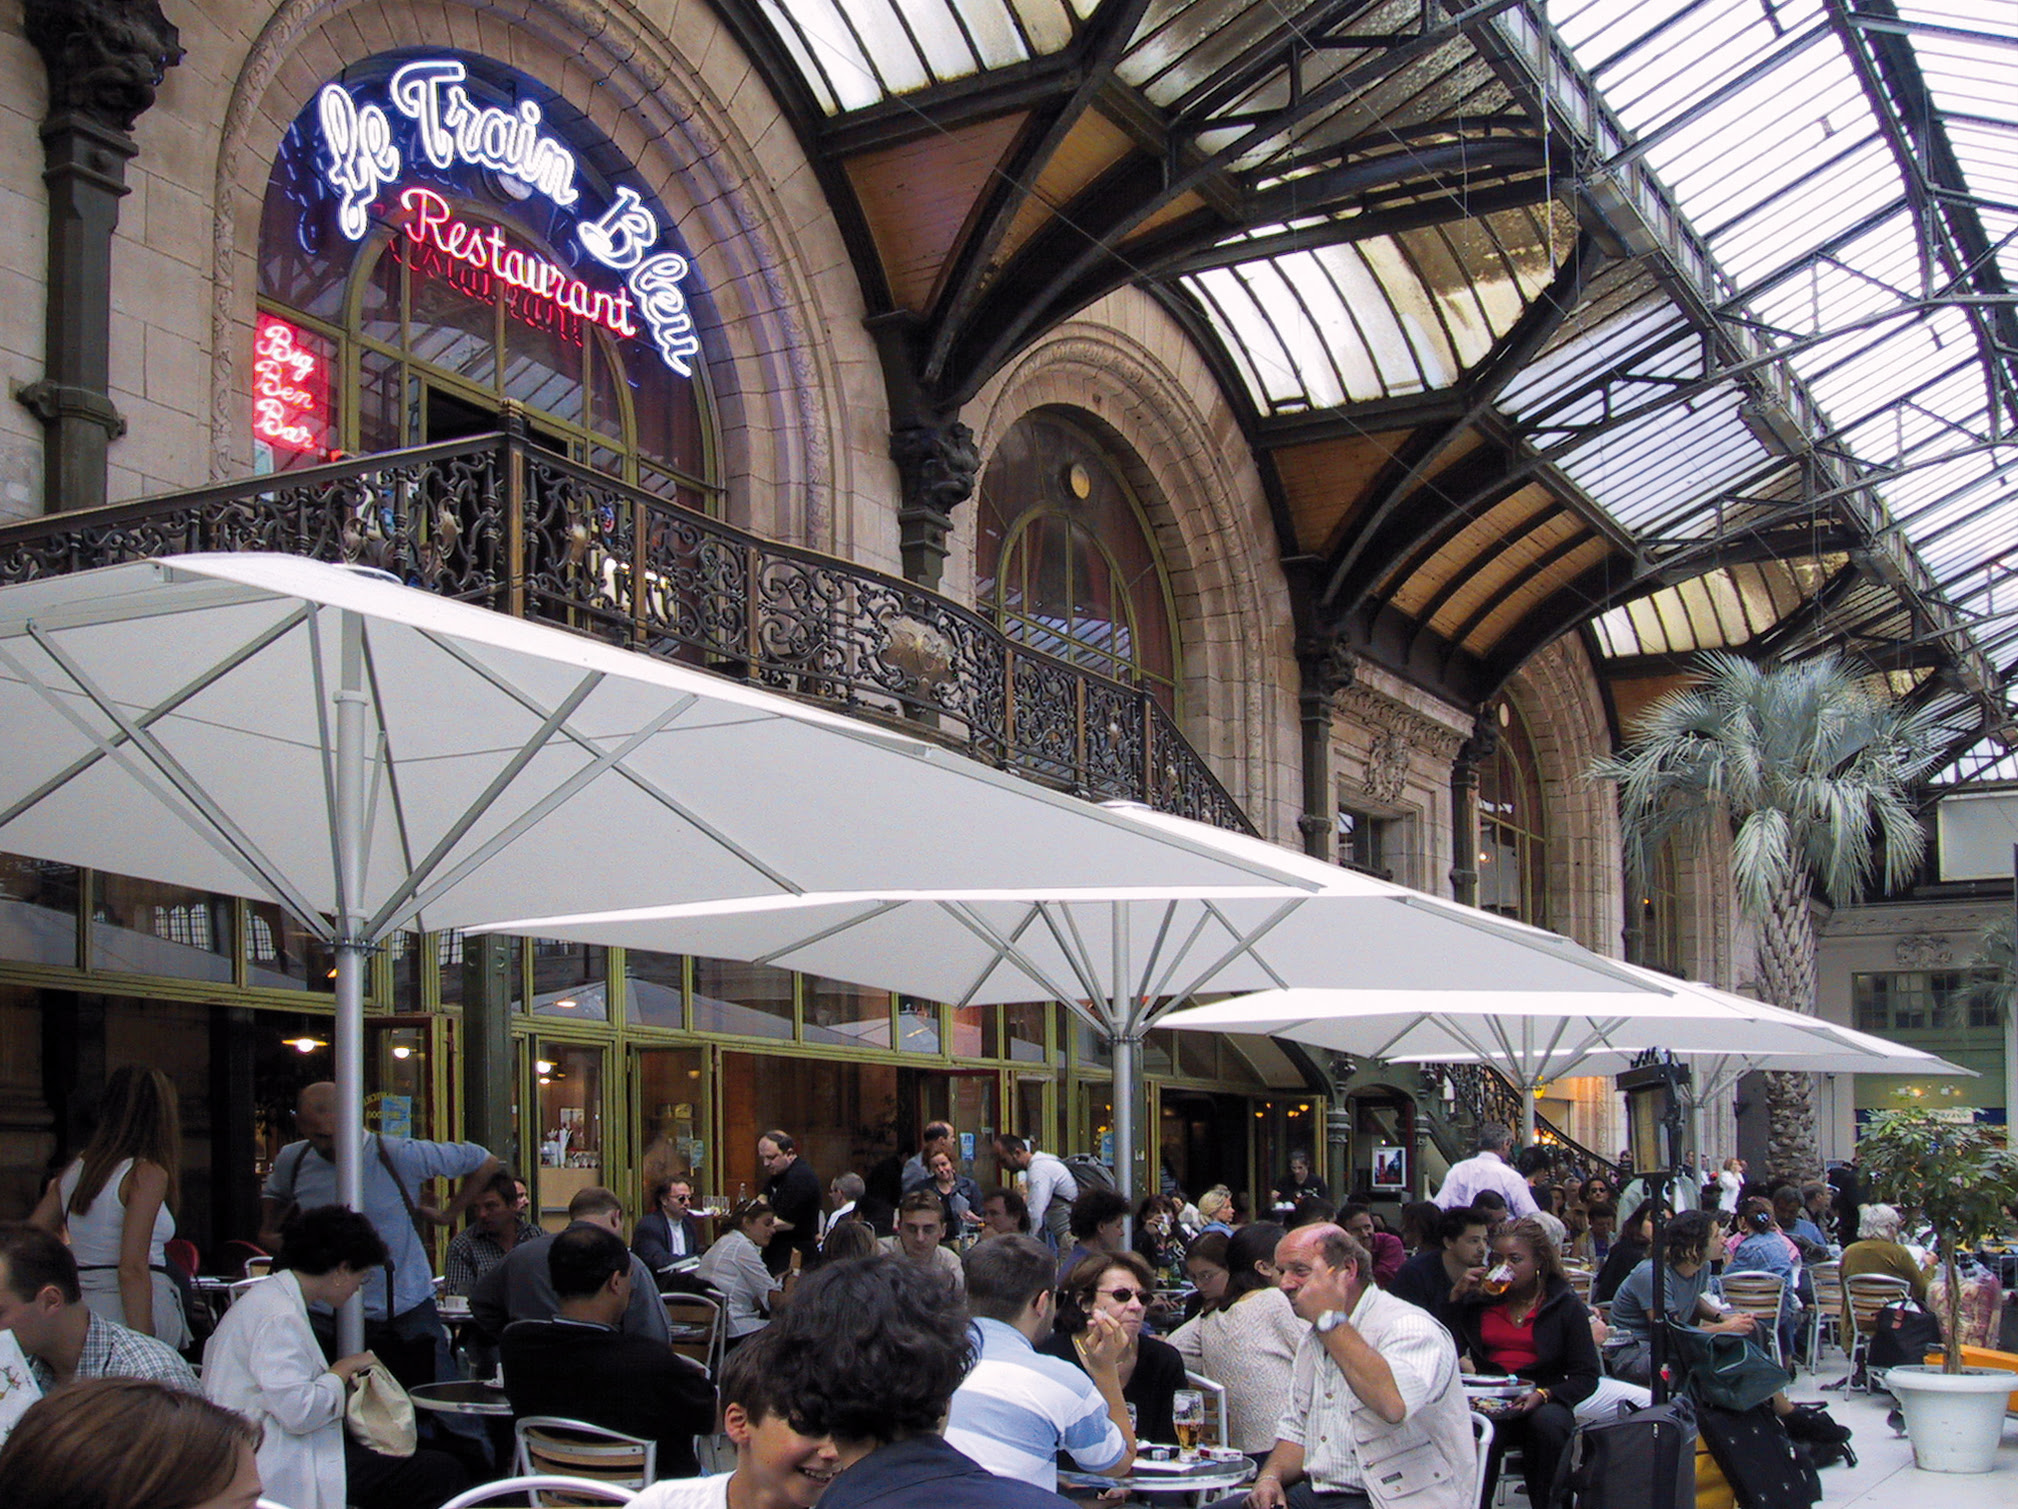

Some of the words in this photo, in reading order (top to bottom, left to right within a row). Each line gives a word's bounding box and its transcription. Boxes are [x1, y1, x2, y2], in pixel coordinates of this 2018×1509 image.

[318, 83, 402, 242] Le
[389, 60, 580, 206] Train
[575, 184, 700, 378] Bleu
[400, 187, 639, 339] Restaurant
[256, 325, 315, 382] Big
[253, 359, 315, 410] Ben
[252, 398, 317, 448] Bar
